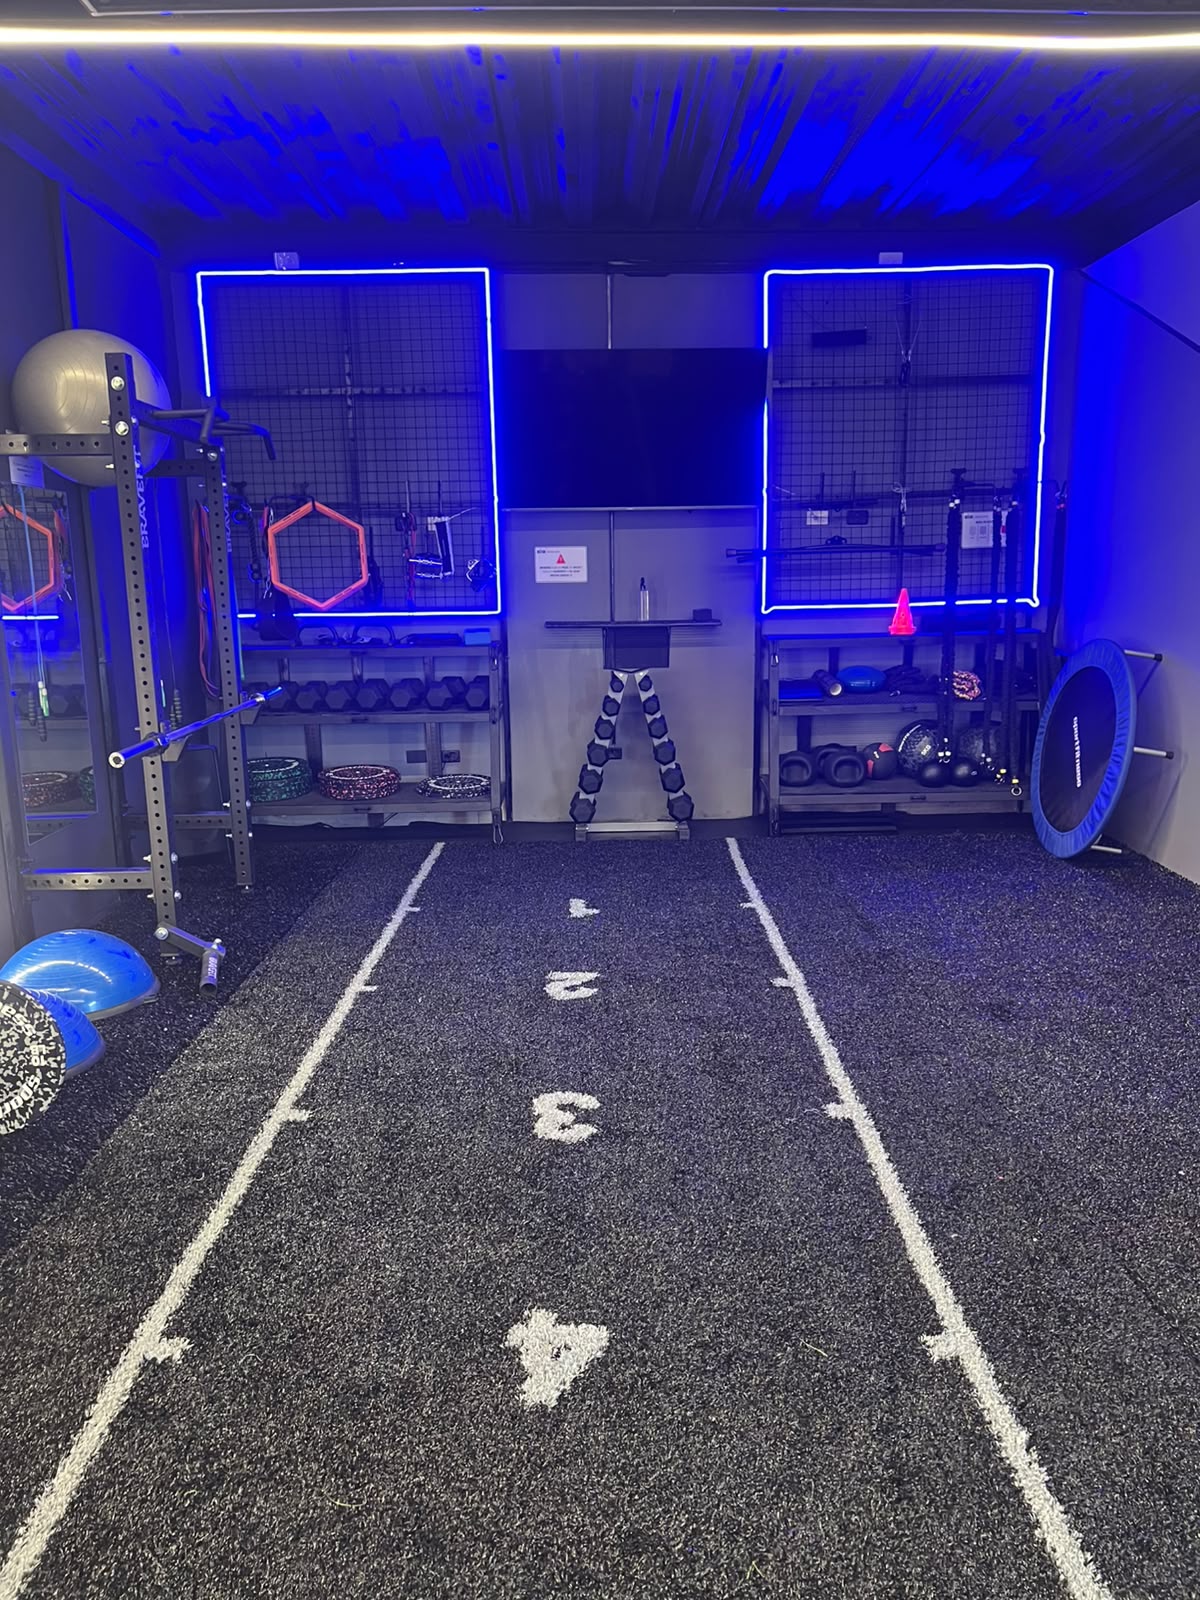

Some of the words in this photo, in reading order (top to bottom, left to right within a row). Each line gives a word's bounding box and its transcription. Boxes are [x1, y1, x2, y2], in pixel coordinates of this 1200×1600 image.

[133, 445, 149, 549] BRAVEFT
[544, 971, 599, 1000] 2
[532, 1091, 600, 1143] 3
[505, 1307, 610, 1408] 4
